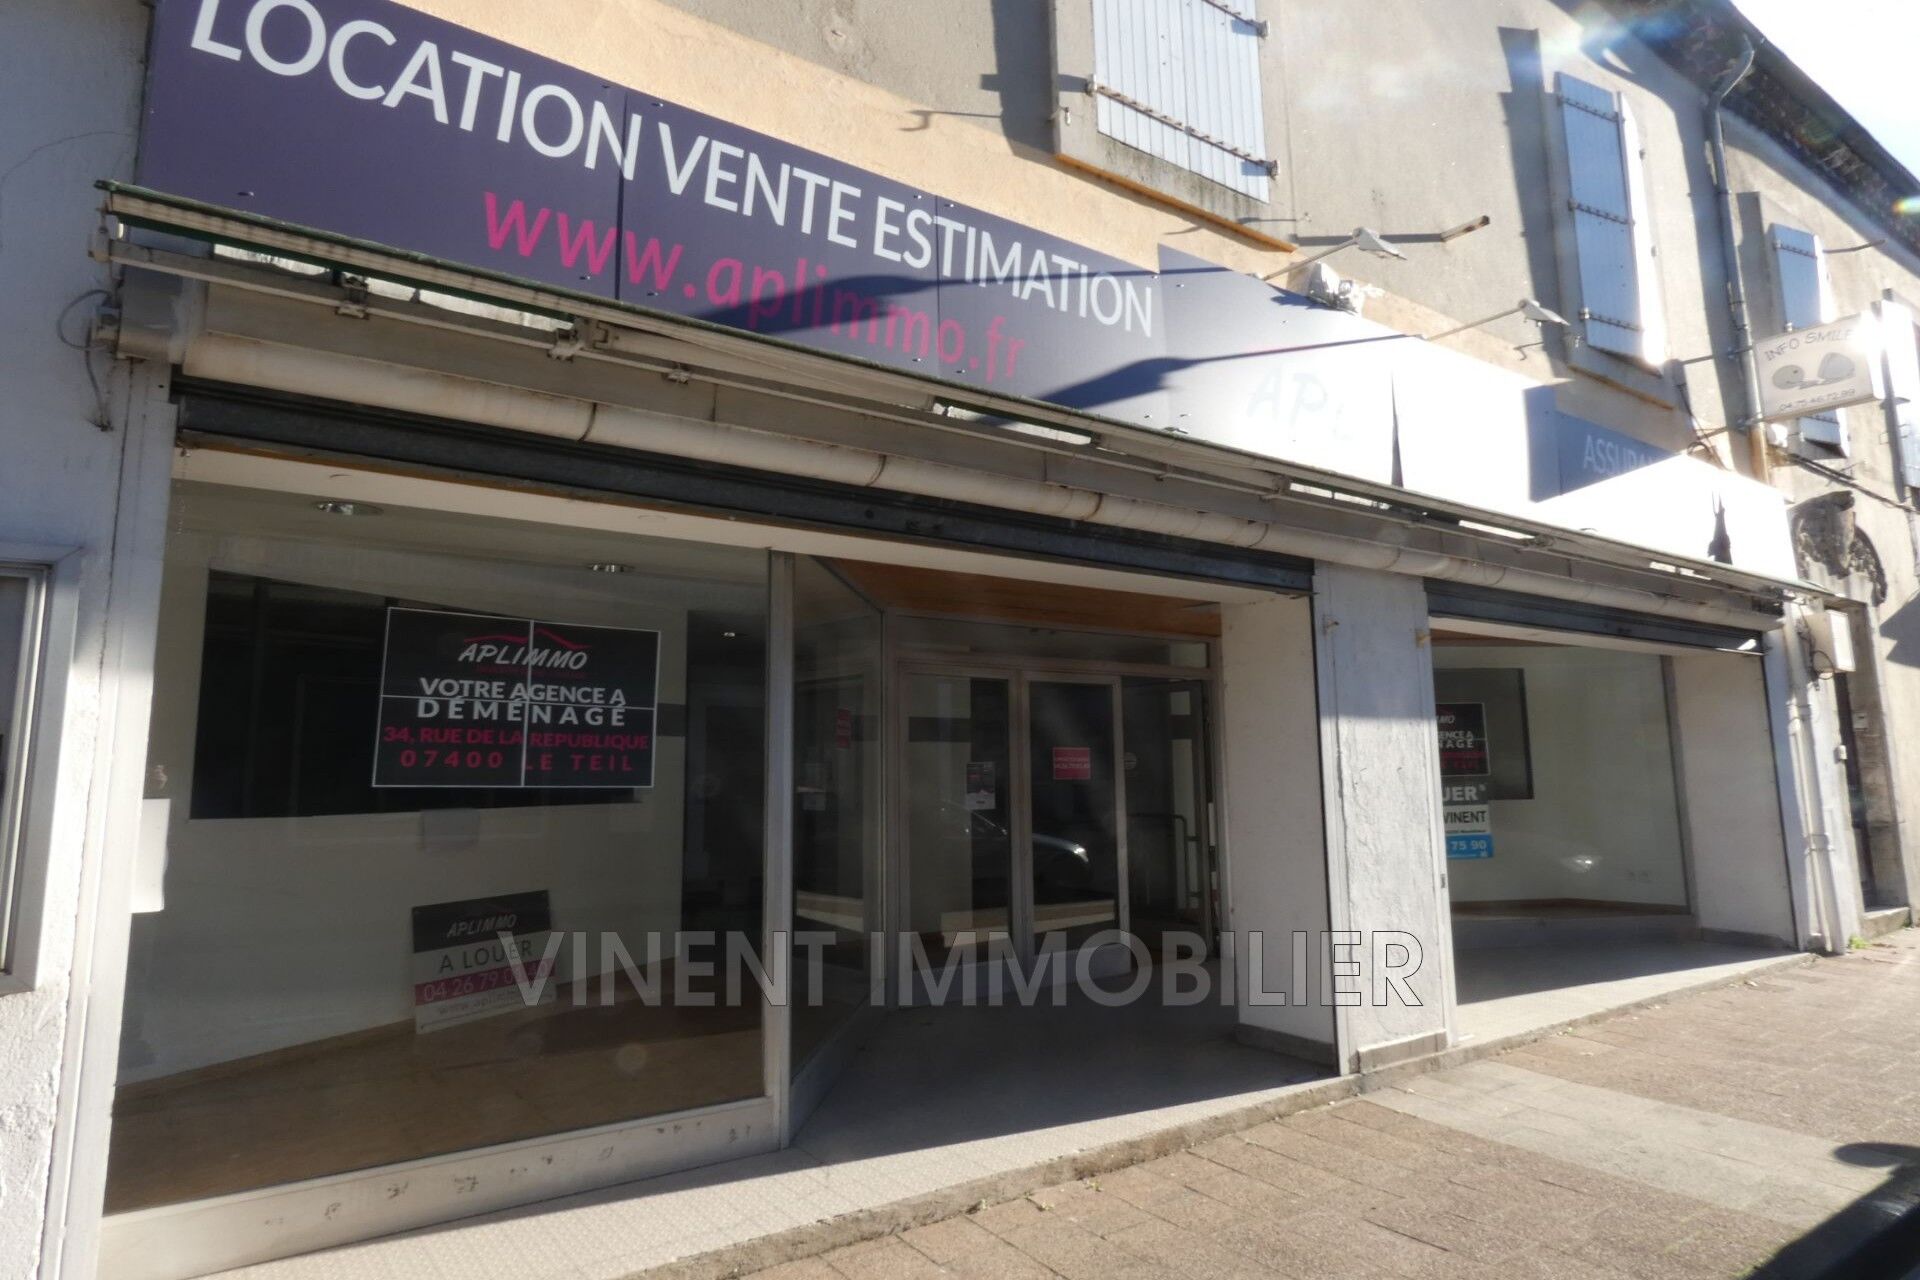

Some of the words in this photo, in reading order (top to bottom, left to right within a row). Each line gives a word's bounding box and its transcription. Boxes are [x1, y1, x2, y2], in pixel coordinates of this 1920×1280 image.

[191, 0, 642, 181] LOCATION
[658, 122, 858, 249] VENTE
[874, 195, 1153, 338] ESTIMATION
[484, 191, 1026, 382] www.aplimmo.fr
[1764, 337, 1800, 361] INFO
[458, 643, 588, 670] APLIMMO
[420, 677, 506, 699] VOTRE
[509, 683, 606, 704] AGENCE
[420, 728, 462, 744] RUE
[466, 729, 495, 745] DE
[499, 731, 522, 745] LA
[400, 750, 504, 769] 07400
[571, 754, 633, 771] TEIL
[447, 914, 518, 939] APLIMMO
[463, 939, 533, 969] LOUER
[452, 979, 474, 996] 26
